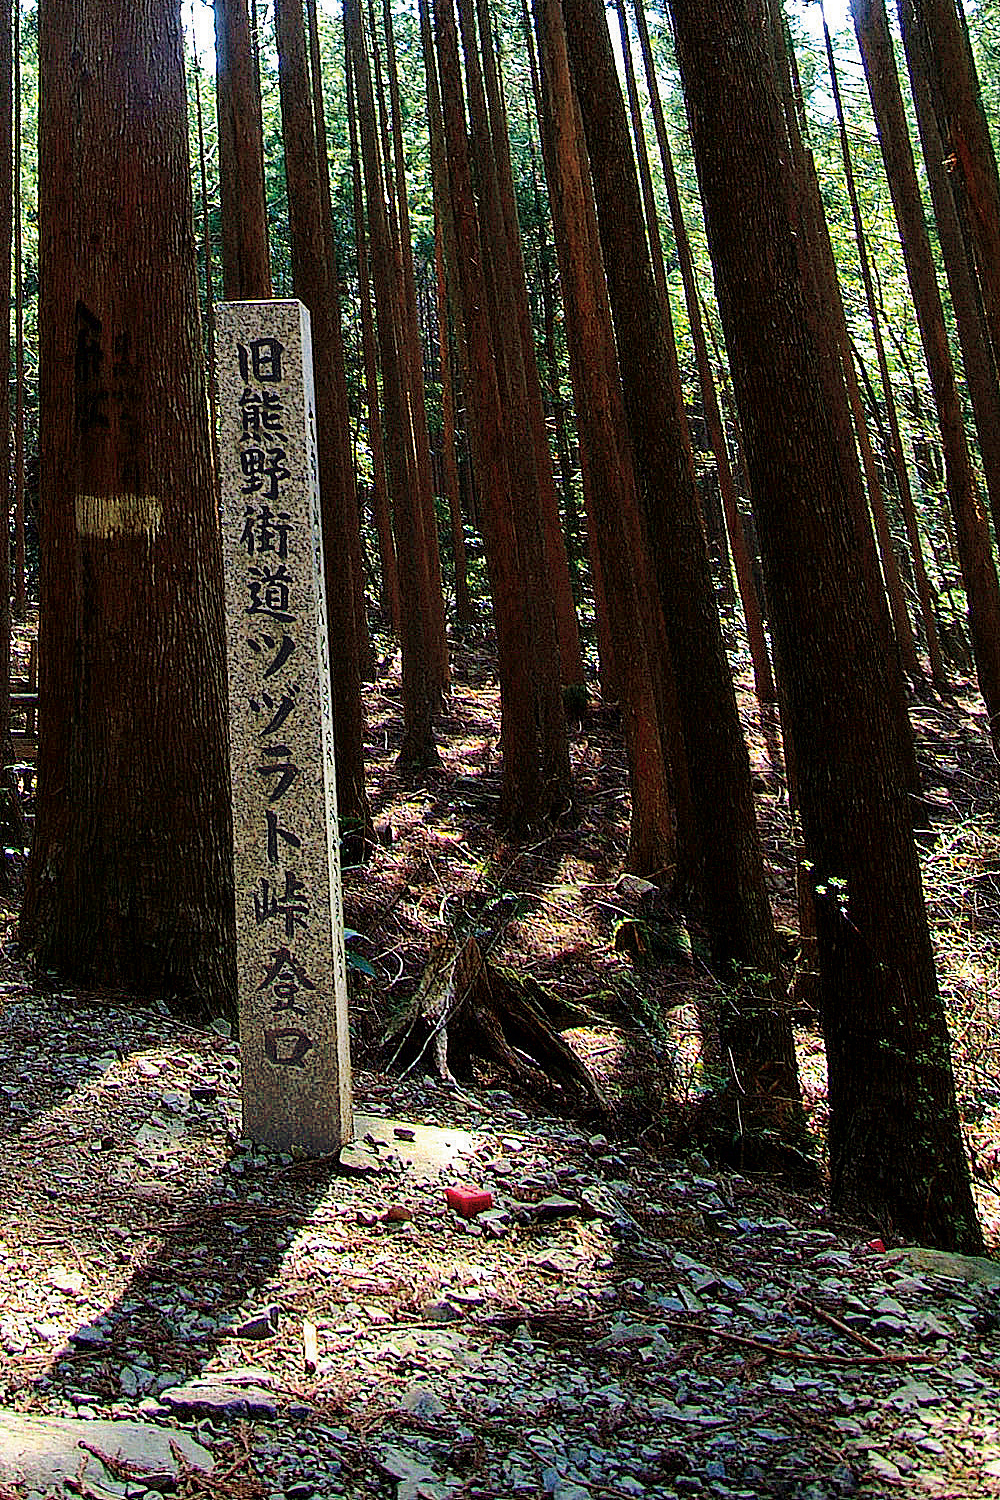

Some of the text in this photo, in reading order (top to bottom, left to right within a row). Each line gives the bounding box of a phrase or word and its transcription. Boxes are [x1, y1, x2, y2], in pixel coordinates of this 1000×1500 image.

[238, 337, 314, 1067] 旧熊野街道ツヅラト峠登口
